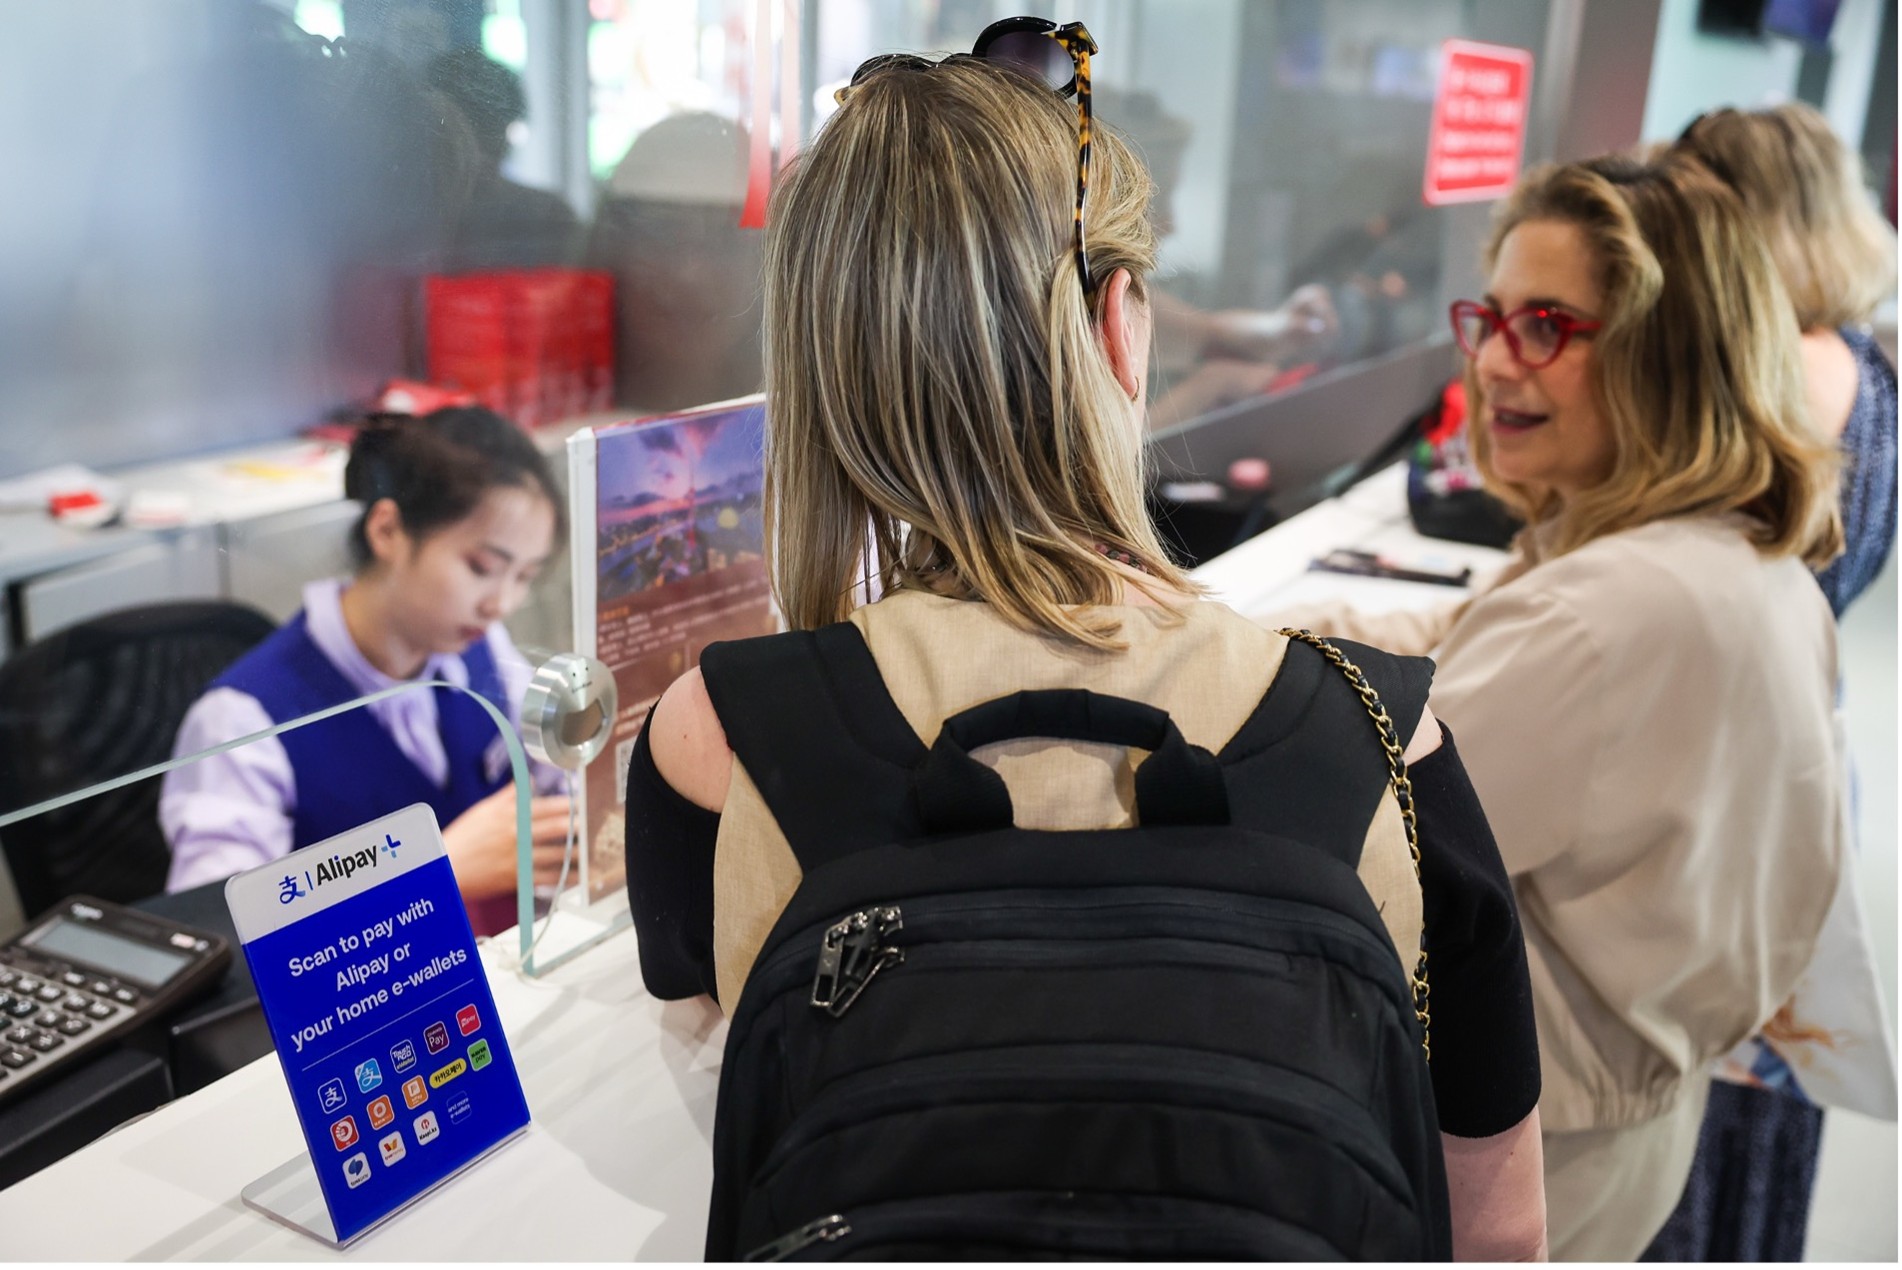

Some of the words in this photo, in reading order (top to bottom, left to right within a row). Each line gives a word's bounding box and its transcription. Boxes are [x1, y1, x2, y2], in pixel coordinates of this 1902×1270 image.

[288, 945, 338, 977] Scan
[339, 935, 359, 954] to
[362, 918, 393, 948] pay
[397, 898, 435, 926] with
[335, 953, 389, 992] Alipay
[393, 942, 411, 962] or
[291, 1015, 334, 1053] your
[336, 988, 389, 1025] home
[392, 948, 467, 996] e-wallets
[428, 1033, 445, 1048] Pay
